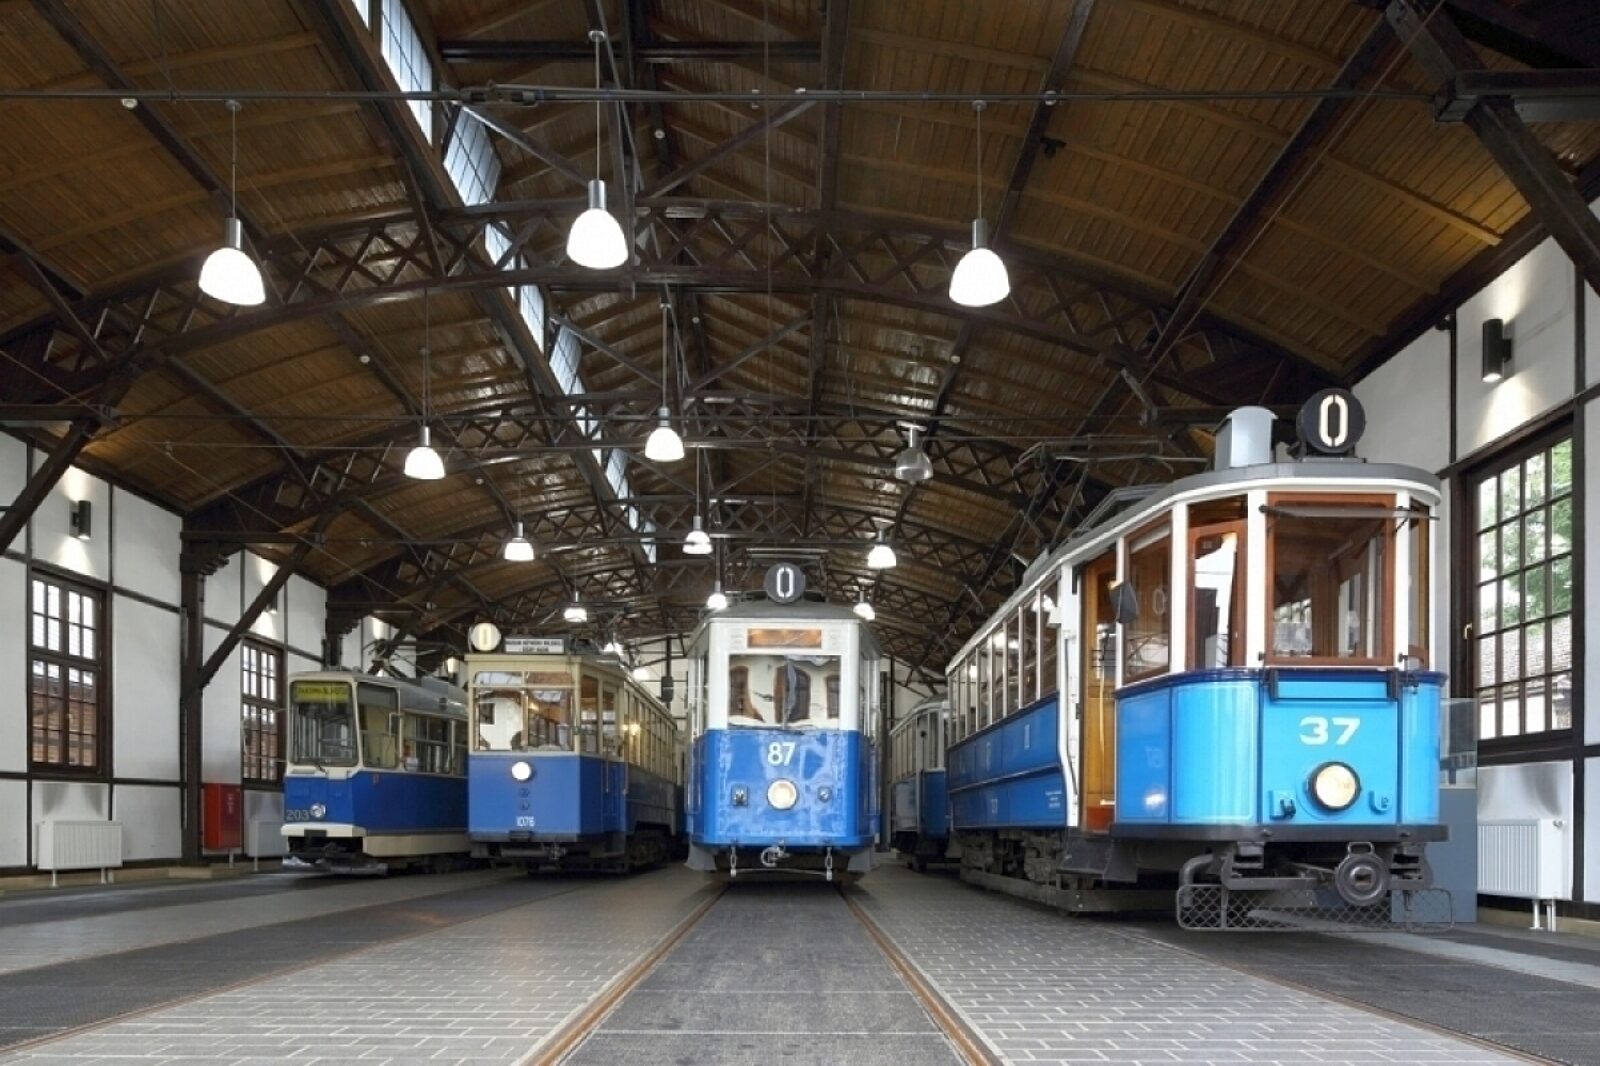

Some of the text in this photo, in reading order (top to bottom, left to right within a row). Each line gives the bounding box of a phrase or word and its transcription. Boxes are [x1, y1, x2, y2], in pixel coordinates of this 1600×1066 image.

[1319, 394, 1348, 447] 0
[776, 566, 794, 598] 0
[1299, 716, 1361, 746] 37
[767, 741, 796, 767] 87
